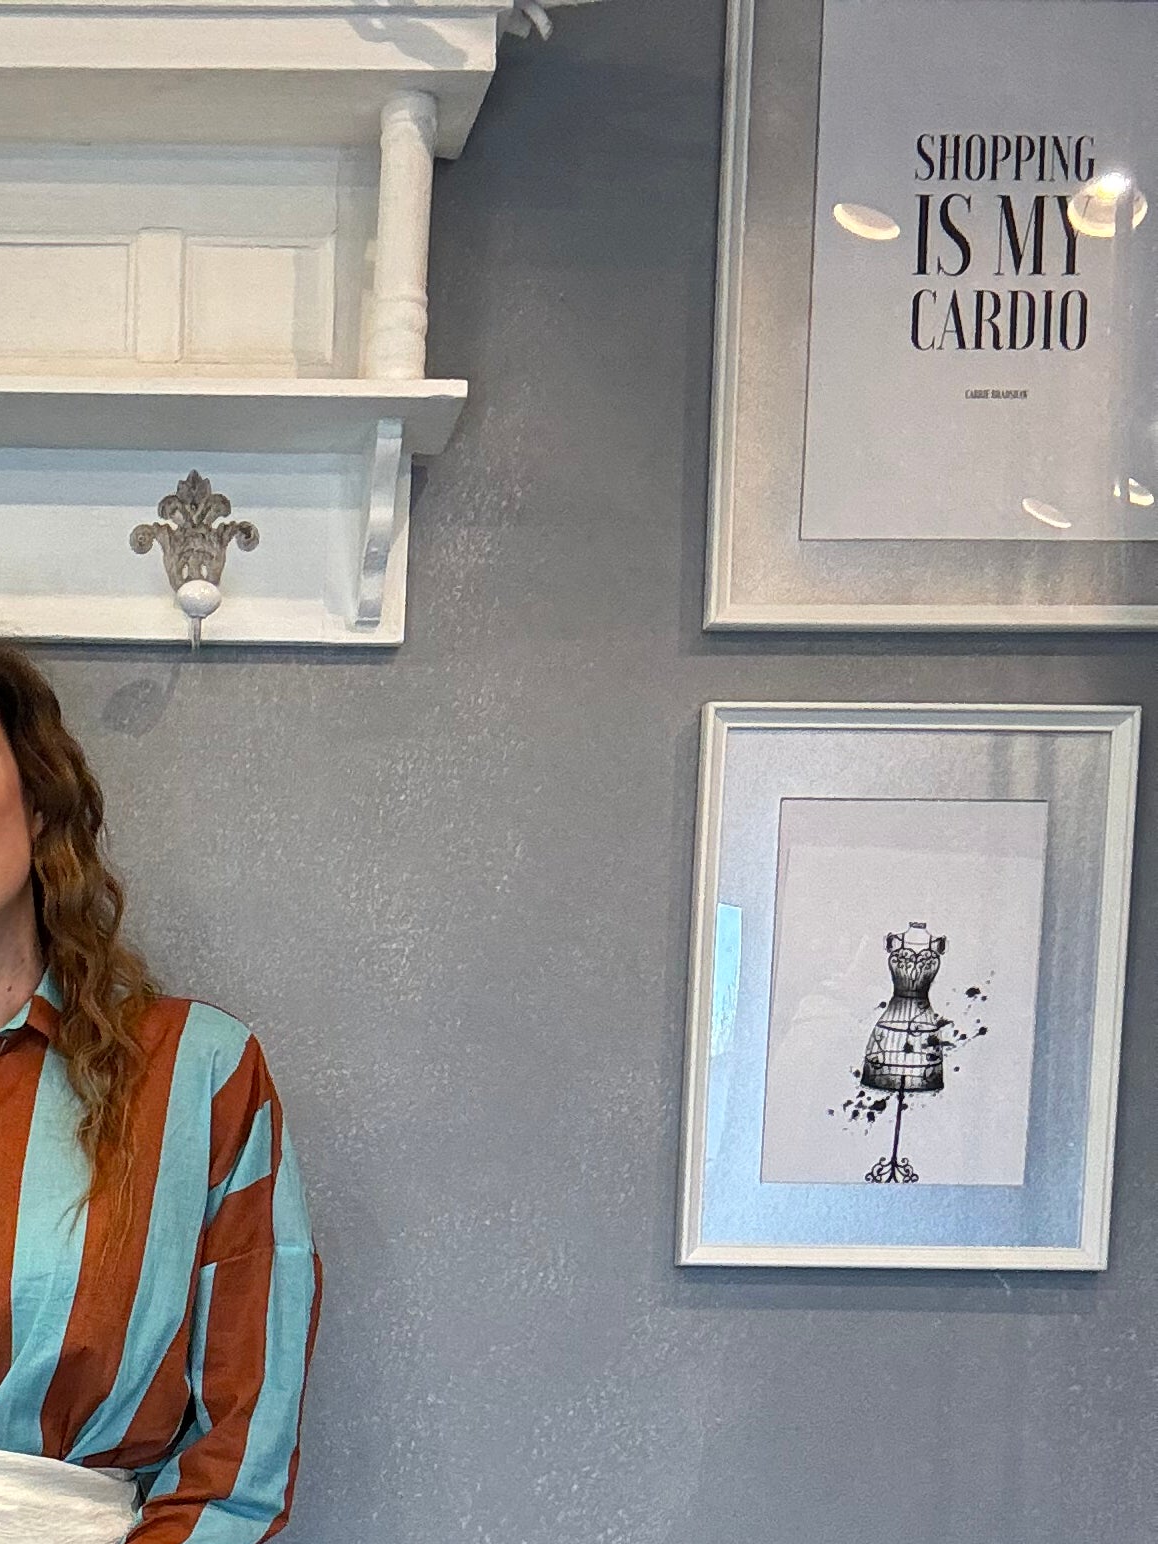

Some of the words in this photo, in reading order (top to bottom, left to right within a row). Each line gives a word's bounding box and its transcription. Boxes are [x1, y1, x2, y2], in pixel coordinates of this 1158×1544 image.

[915, 134, 1095, 182] SHOPPING
[912, 193, 972, 276] IS
[994, 194, 1095, 276] MY
[911, 289, 1088, 351] CARDIO
